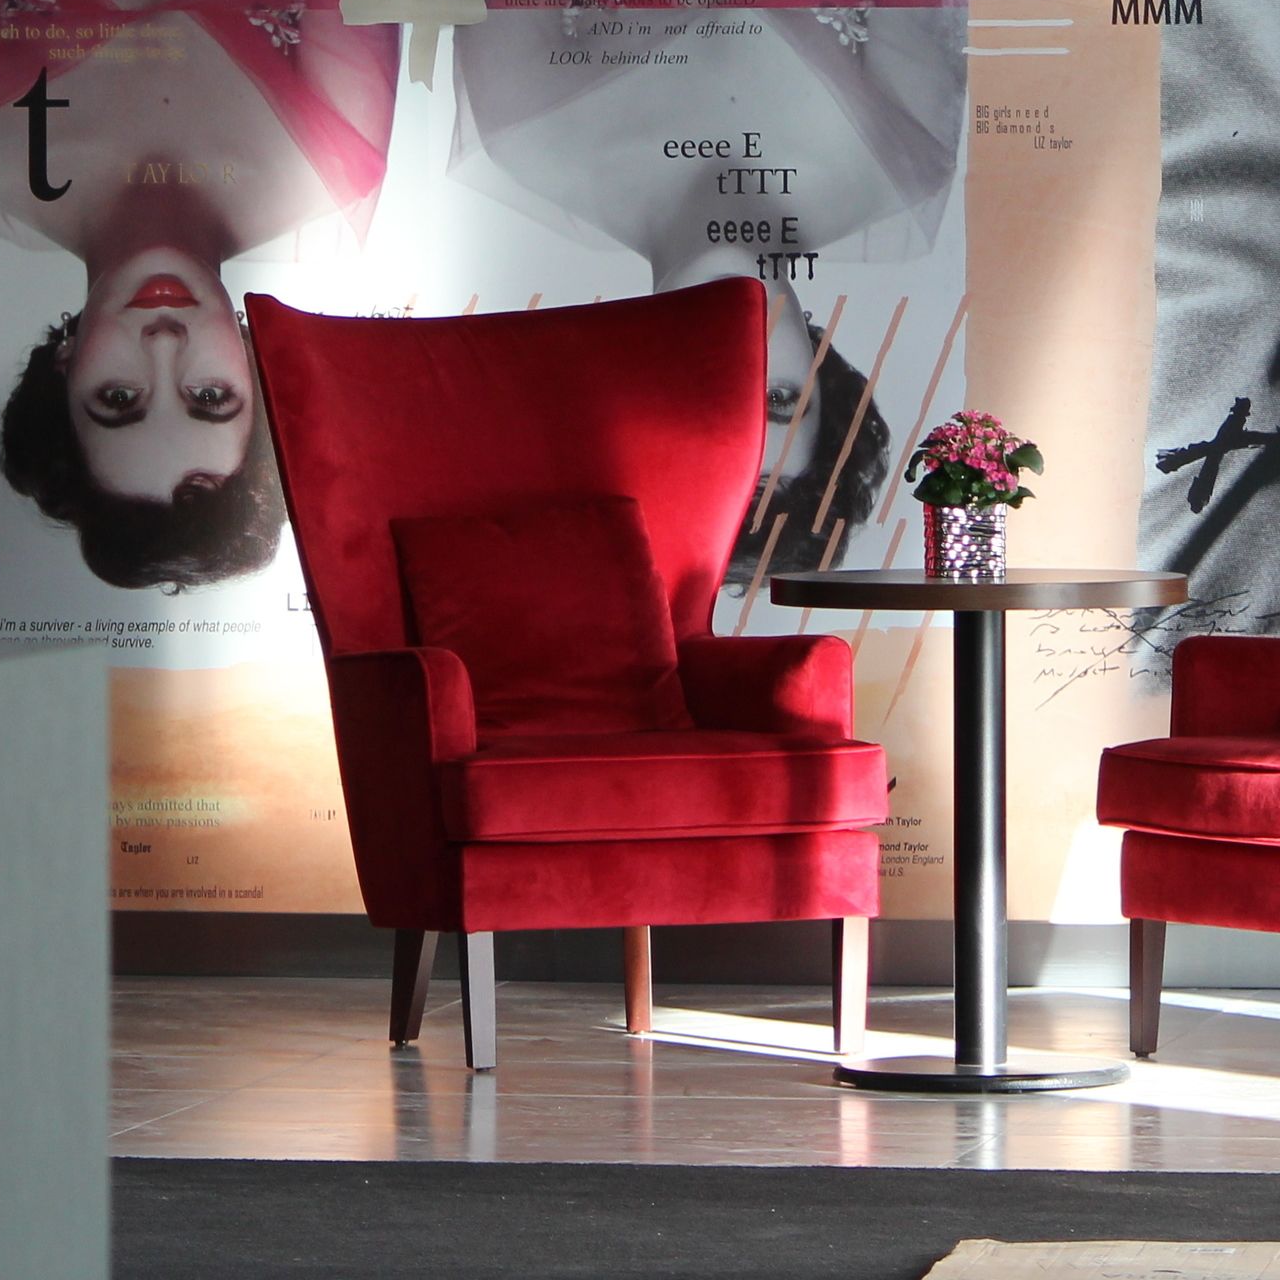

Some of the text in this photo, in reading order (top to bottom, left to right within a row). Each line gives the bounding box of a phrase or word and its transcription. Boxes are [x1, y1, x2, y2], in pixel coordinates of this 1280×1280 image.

[25, 25, 41, 40] to
[75, 27, 94, 40] so
[587, 22, 624, 35] AND
[664, 23, 687, 35] not
[695, 21, 744, 38] affraid
[748, 23, 763, 35] to
[48, 44, 86, 60] such
[601, 50, 650, 65] behind
[654, 50, 689, 65] them
[976, 105, 1012, 121] BIG girls
[12, 65, 73, 203] t
[976, 120, 990, 134] BIG
[663, 132, 763, 159] eeee E
[1034, 135, 1073, 151] LIZ taylor
[716, 168, 797, 195] tTTT
[706, 217, 799, 244] eeee E
[19, 621, 26, 632] a
[29, 619, 75, 633] surviver
[84, 621, 92, 632] a
[94, 619, 125, 635] living
[127, 619, 176, 635] example
[178, 619, 191, 632] of
[192, 619, 220, 632] what
[111, 635, 155, 650] survive.
[136, 799, 221, 812] admitted that
[115, 815, 130, 828] by
[896, 816, 922, 828] Taylor
[903, 842, 929, 853] Taylor
[912, 854, 945, 867] England
[219, 885, 226, 899] in
